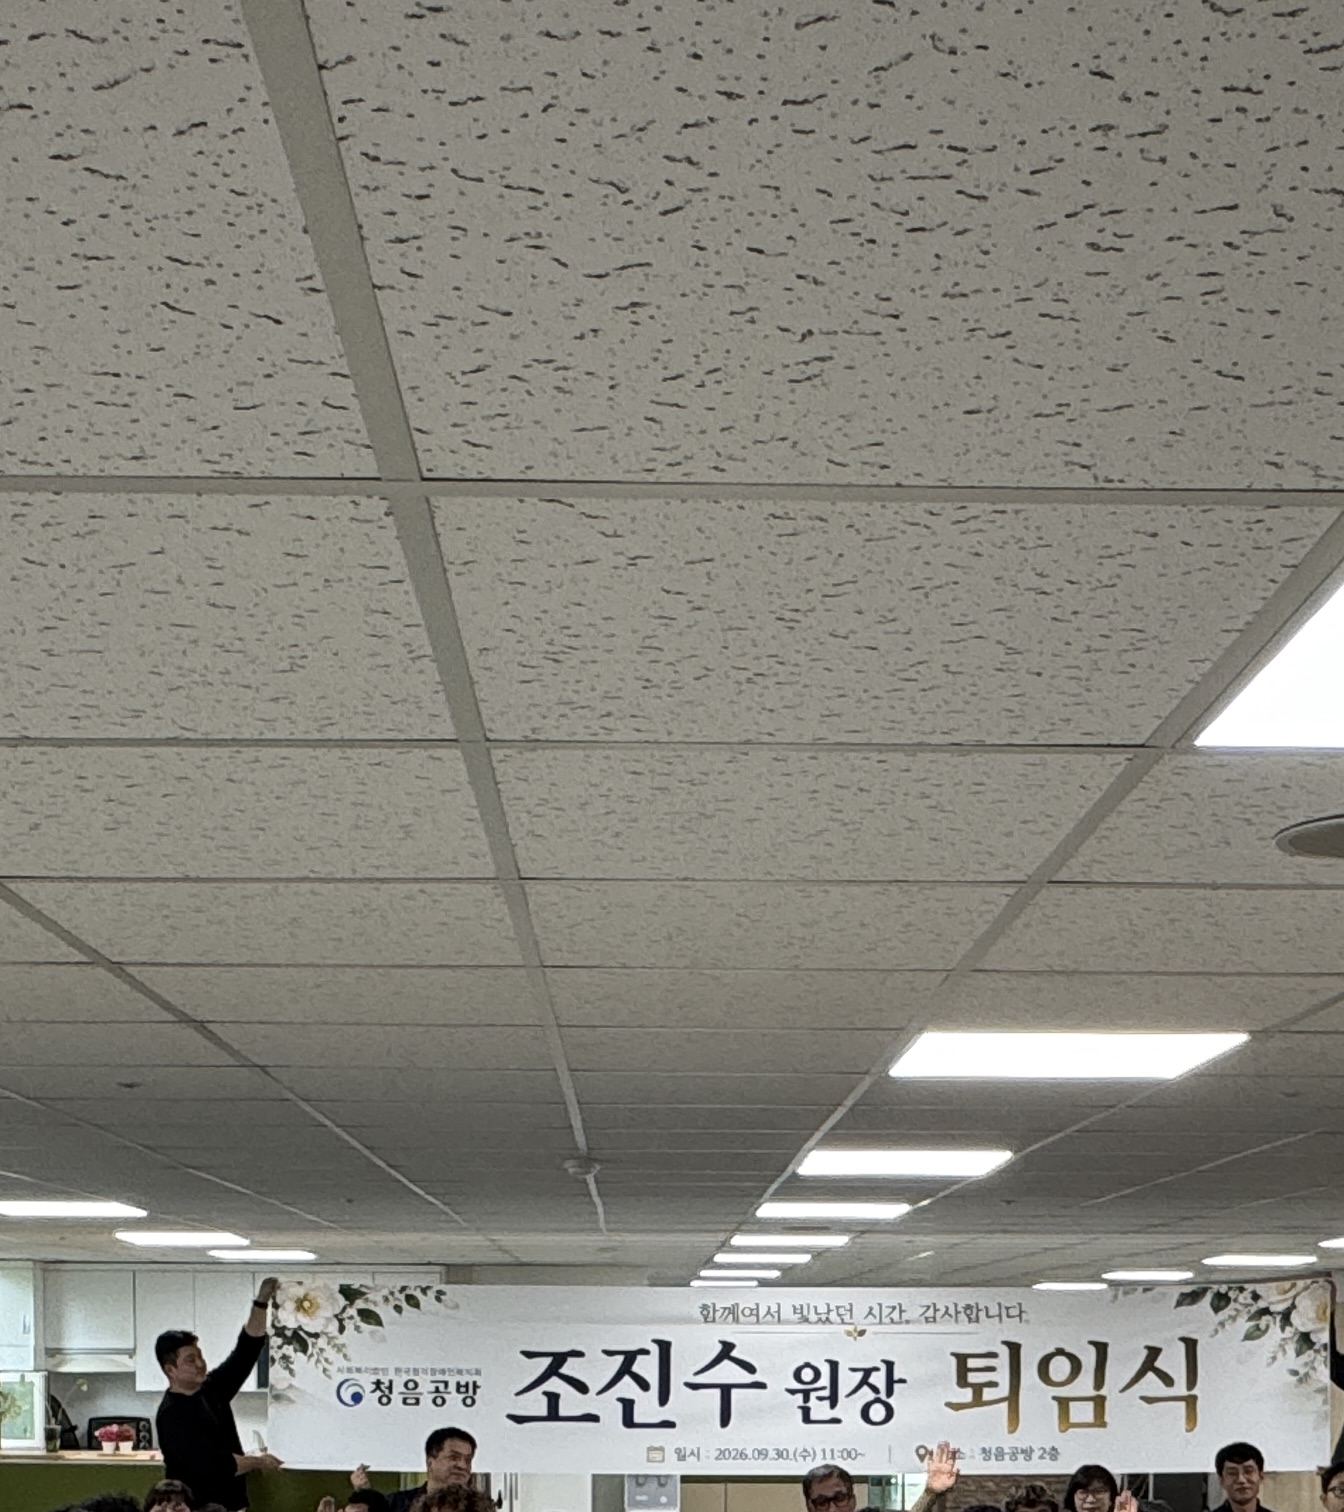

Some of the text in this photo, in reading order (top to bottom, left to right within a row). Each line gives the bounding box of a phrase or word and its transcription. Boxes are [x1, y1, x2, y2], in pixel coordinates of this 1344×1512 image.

[698, 1302, 781, 1324] 함께여서
[791, 1302, 855, 1325] 빛났던
[370, 1378, 482, 1408] 청음공방
[506, 1336, 1199, 1434] 조진수 원장 퇴임식
[674, 1447, 700, 1462] 일시
[821, 1448, 865, 1461] 11:00~
[980, 1446, 1034, 1462] 청음공방
[1037, 1445, 1060, 1461] 2층
